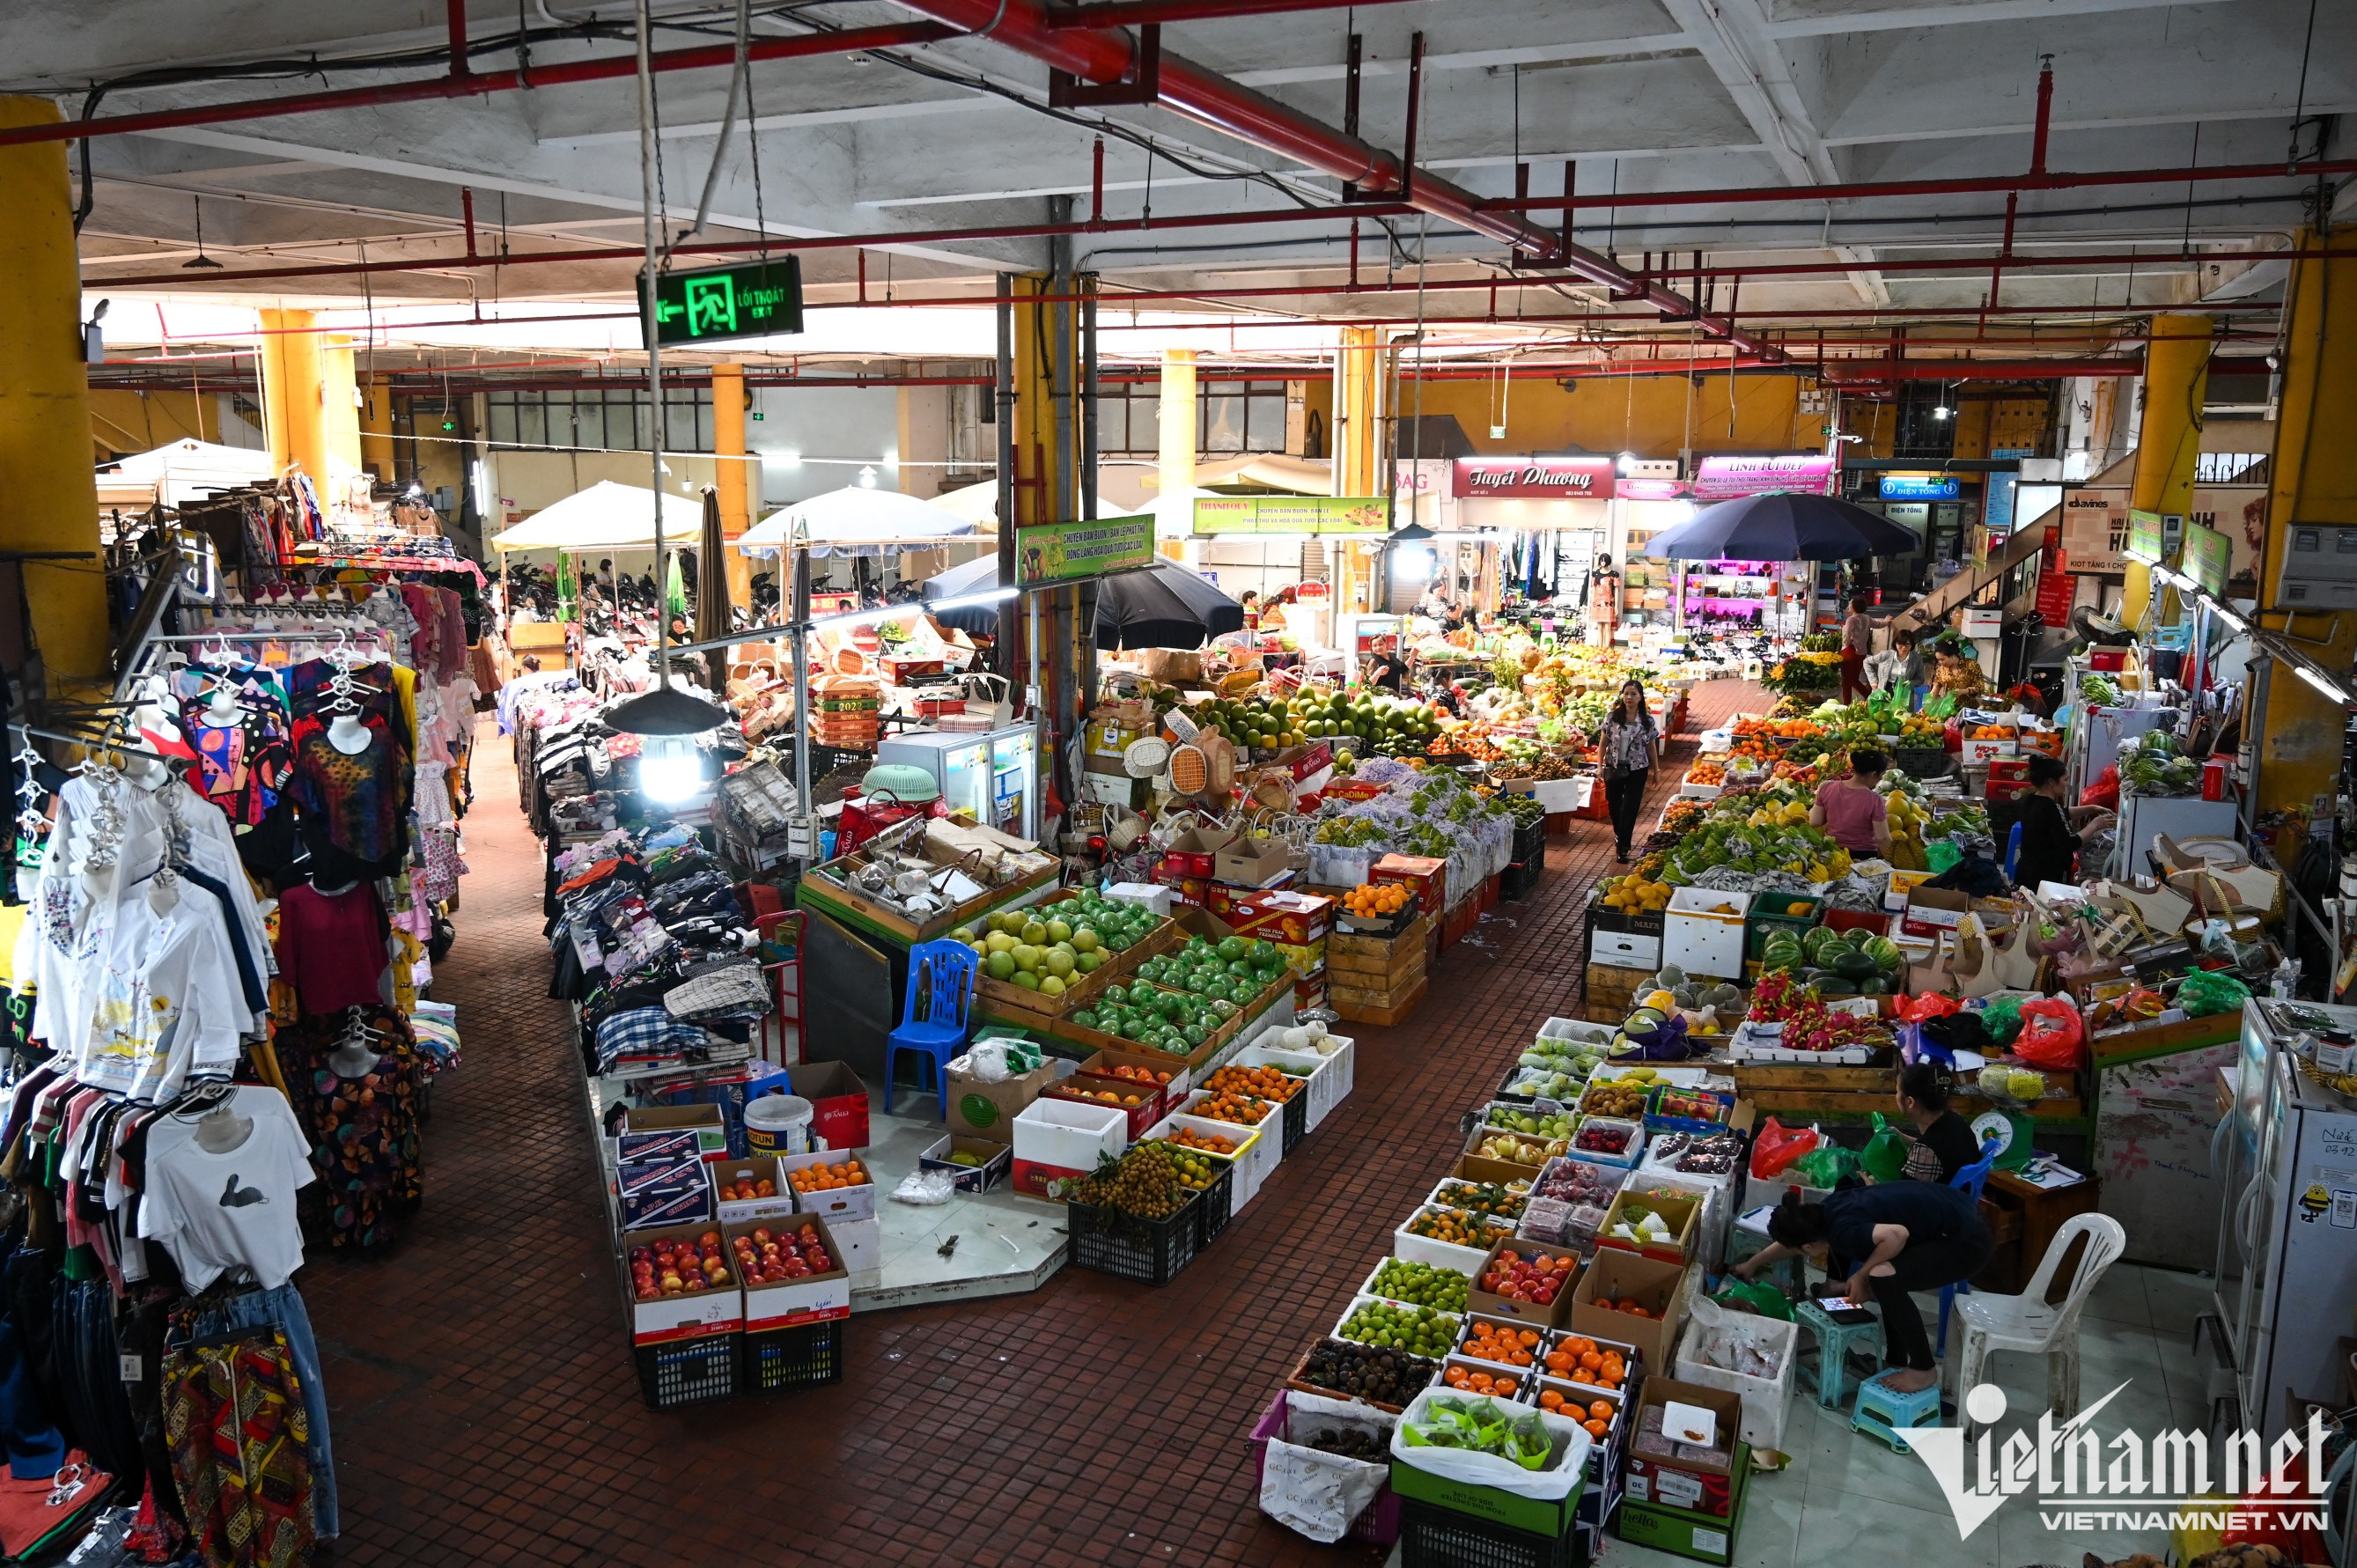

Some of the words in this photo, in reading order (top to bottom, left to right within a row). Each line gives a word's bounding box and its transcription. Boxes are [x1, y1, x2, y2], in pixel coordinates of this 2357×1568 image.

[737, 285, 753, 307] LỐI
[1469, 467, 1517, 489] Tuyết
[1521, 466, 1592, 490] Phương
[1897, 487, 1917, 496] ĐIỆN
[1919, 486, 1941, 495] TỔNG
[2067, 494, 2108, 508] davines
[839, 702, 863, 711] 2022
[1338, 790, 1369, 799] CaDiMe
[842, 830, 853, 854] envy
[1634, 920, 1660, 930] MAFA
[832, 1108, 850, 1118] envy
[624, 1137, 670, 1156] CITRUS
[627, 1165, 672, 1187] CITRUS
[667, 1195, 701, 1217] CITRUS
[1269, 1462, 1283, 1471] GC
[1298, 1472, 1318, 1484] GOLDEN
[1331, 1471, 1344, 1481] GC
[1285, 1493, 1300, 1503] GC
[1440, 1492, 1471, 1507] SWEETER
[1453, 1490, 1467, 1500] LIFE
[1468, 1494, 1477, 1503] OF
[1472, 1501, 1485, 1511] THE
[1478, 1497, 1494, 1507] SIDE
[1486, 1505, 1506, 1517] FROM
[1307, 1523, 1322, 1532] GC
